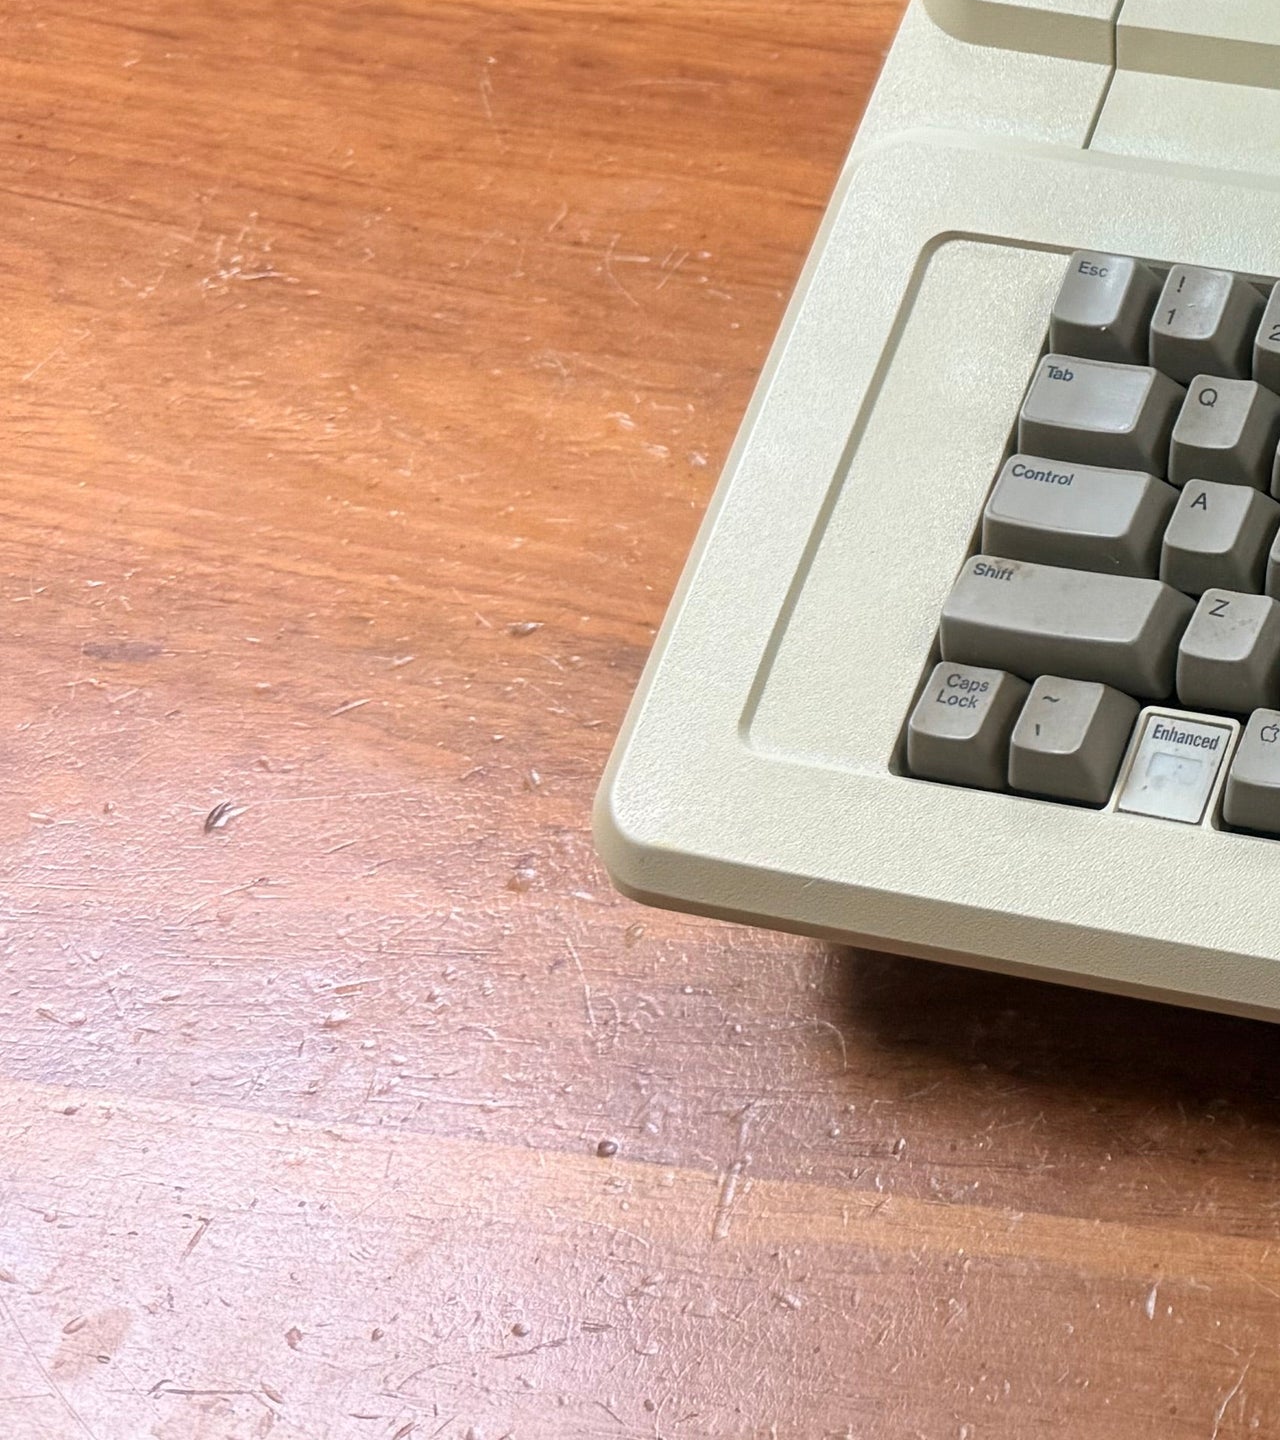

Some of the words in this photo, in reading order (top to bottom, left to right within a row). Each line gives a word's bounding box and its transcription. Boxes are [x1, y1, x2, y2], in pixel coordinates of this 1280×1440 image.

[1077, 260, 1107, 278] Esc
[1047, 365, 1074, 382] Tab
[1198, 387, 1218, 408] Q
[1011, 464, 1074, 486] Control
[1190, 492, 1207, 511] A
[973, 563, 1014, 582] Shift
[1208, 598, 1230, 618] Z
[946, 674, 989, 693] Caps
[935, 691, 979, 710] Lock
[1152, 724, 1220, 751] Enhanced
